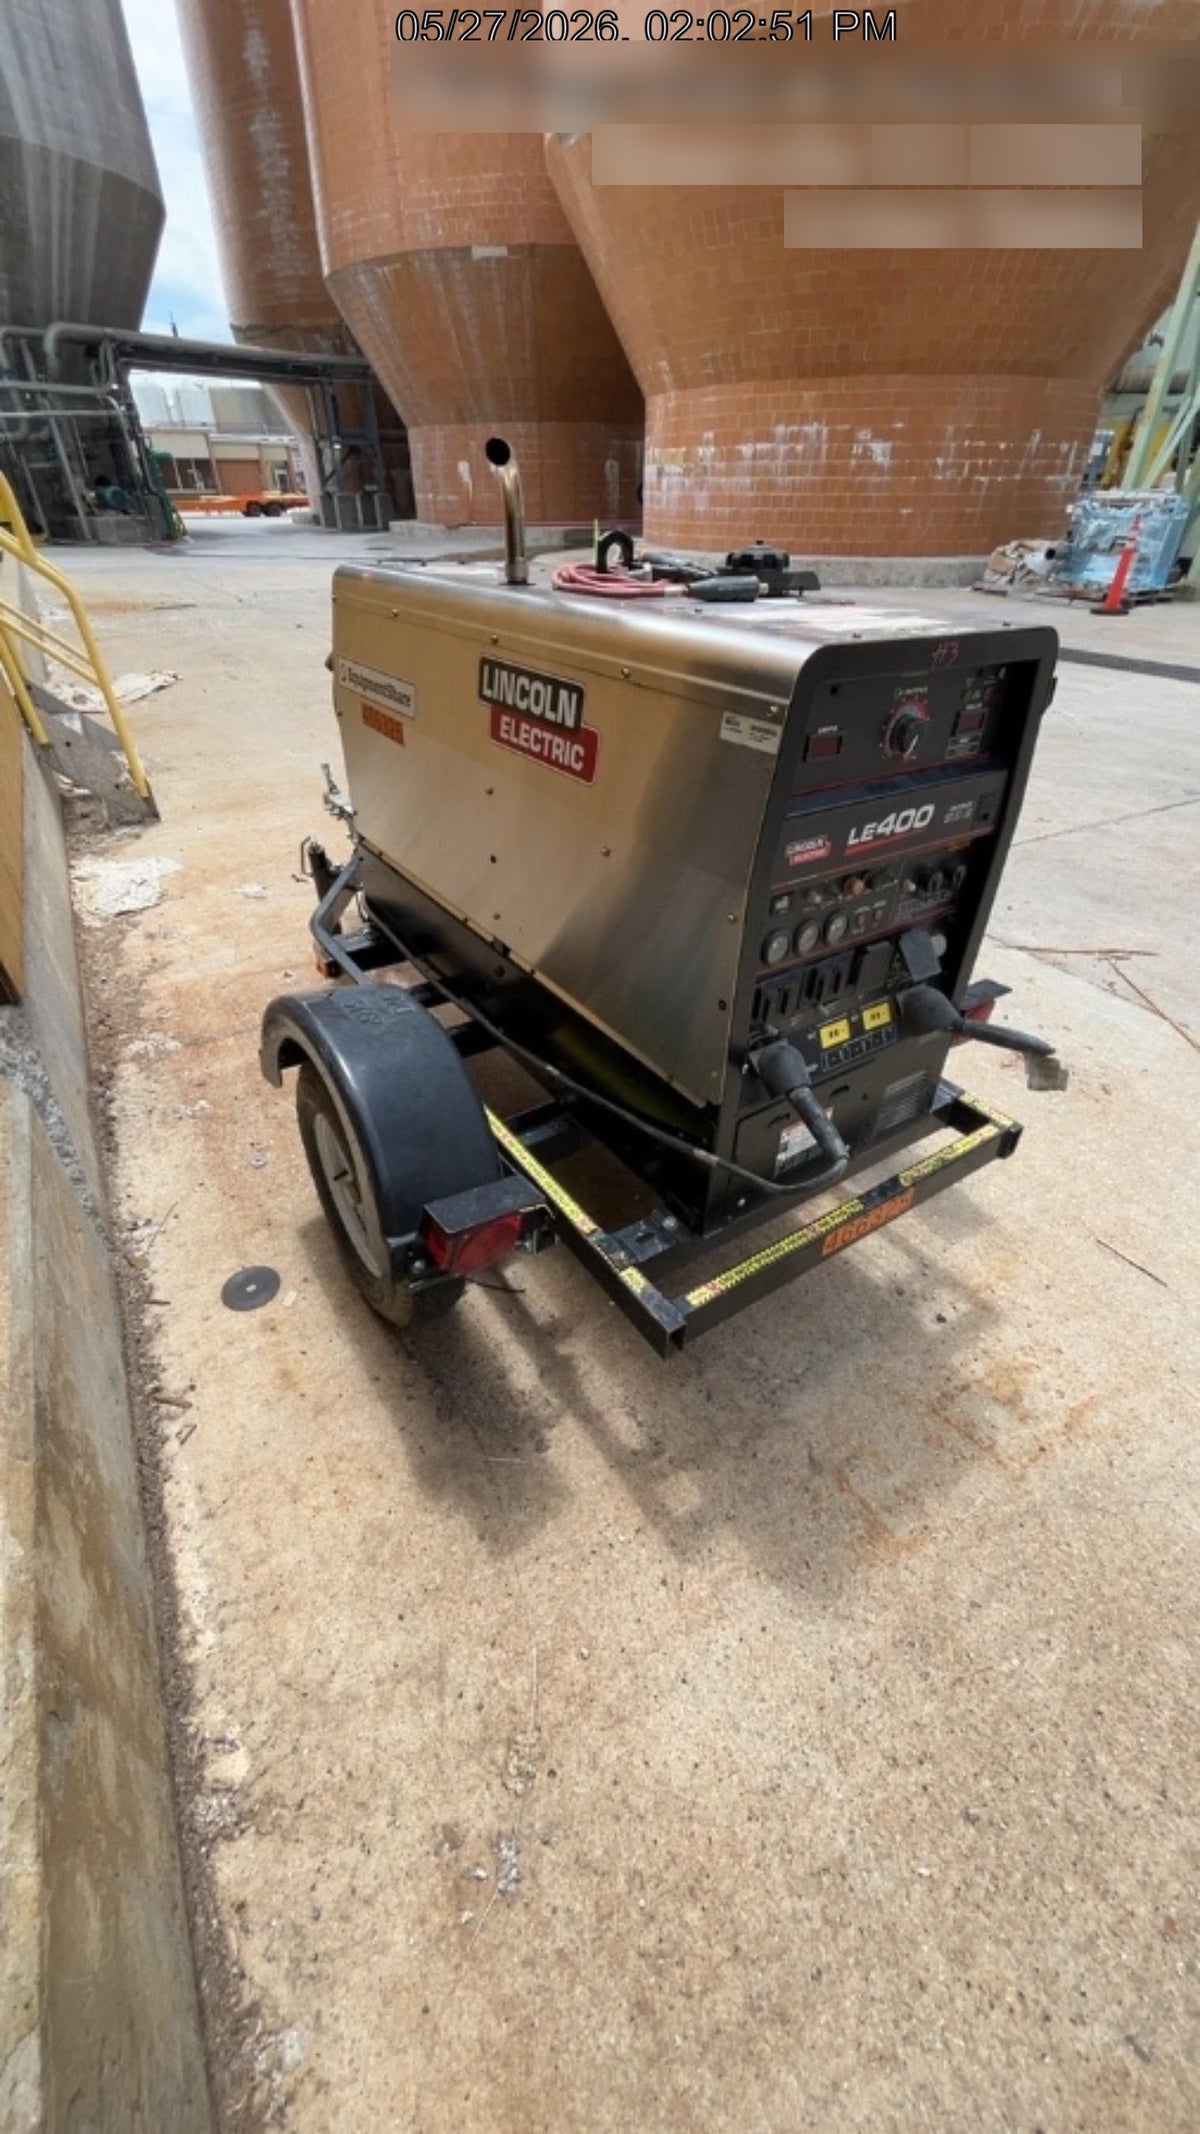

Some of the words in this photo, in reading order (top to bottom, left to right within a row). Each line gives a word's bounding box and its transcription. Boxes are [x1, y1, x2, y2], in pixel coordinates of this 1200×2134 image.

[483, 664, 578, 729] LINCOLN
[500, 715, 584, 771] ELECTRIC
[848, 803, 936, 845] LE400
